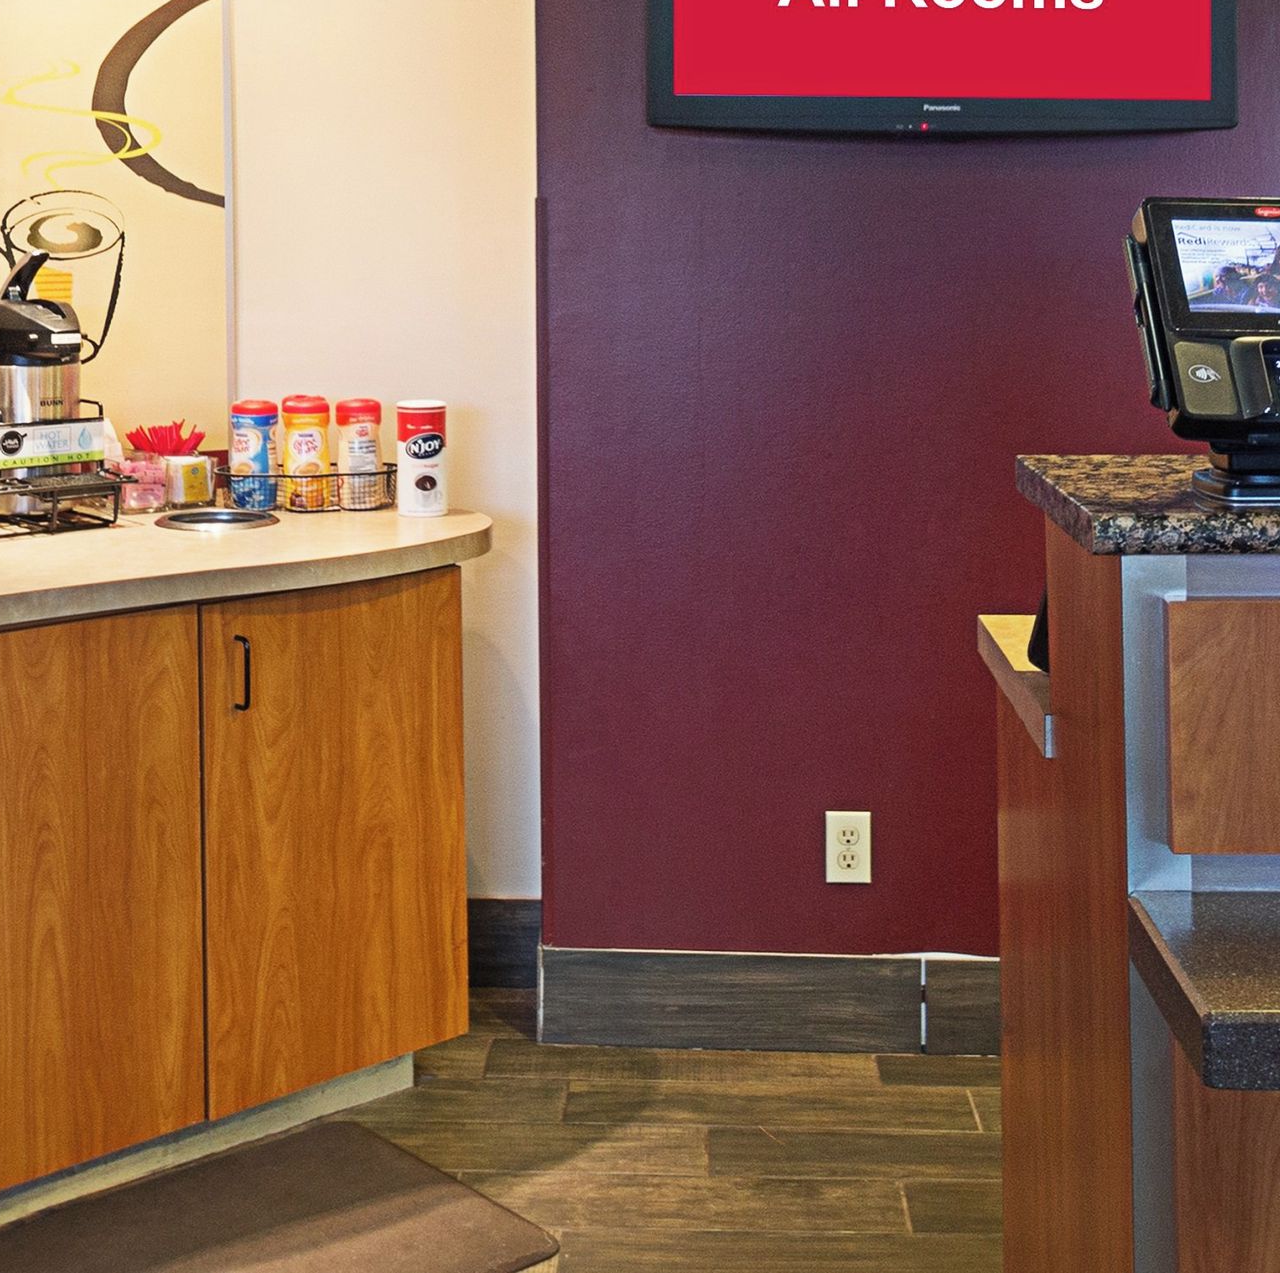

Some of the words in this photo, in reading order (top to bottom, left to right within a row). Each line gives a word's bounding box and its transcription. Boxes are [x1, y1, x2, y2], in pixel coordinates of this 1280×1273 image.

[40, 399, 64, 407] BUNN
[40, 430, 61, 440] HOT
[36, 439, 69, 450] WATER
[2, 455, 60, 467] CAUTION
[67, 452, 91, 461] HOT
